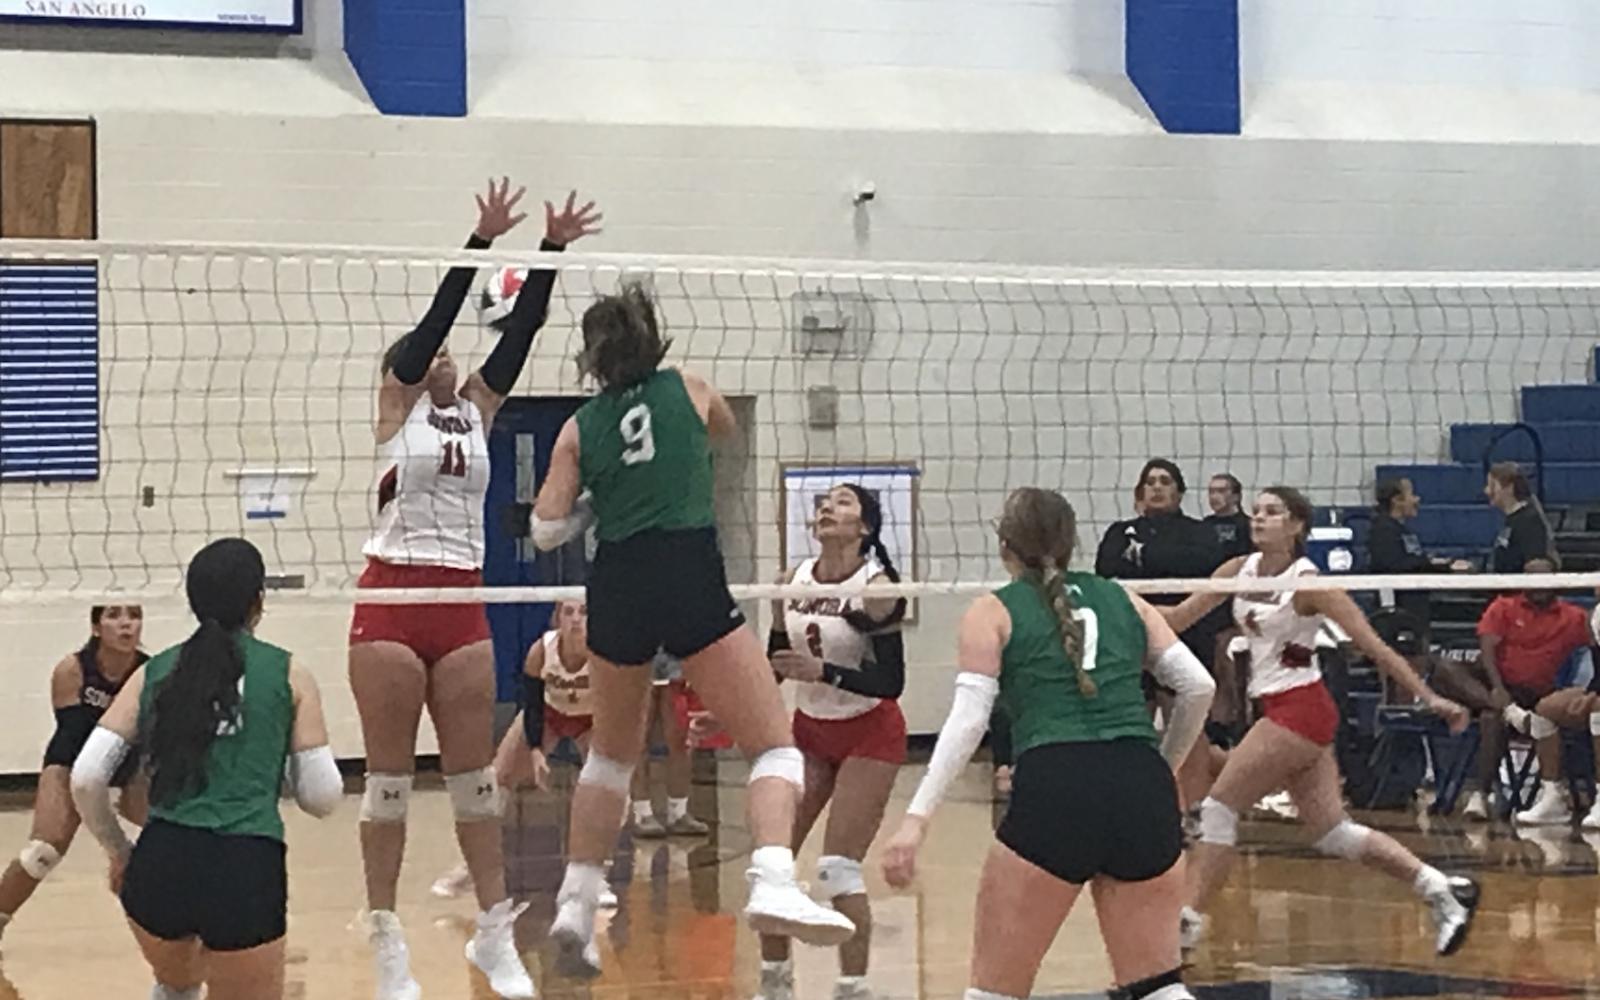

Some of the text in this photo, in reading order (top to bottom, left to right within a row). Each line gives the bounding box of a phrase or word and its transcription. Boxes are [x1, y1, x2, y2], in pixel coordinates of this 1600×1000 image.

[25, 0, 147, 17] SAN ANGELO
[620, 403, 656, 466] 9
[439, 441, 466, 477] 11
